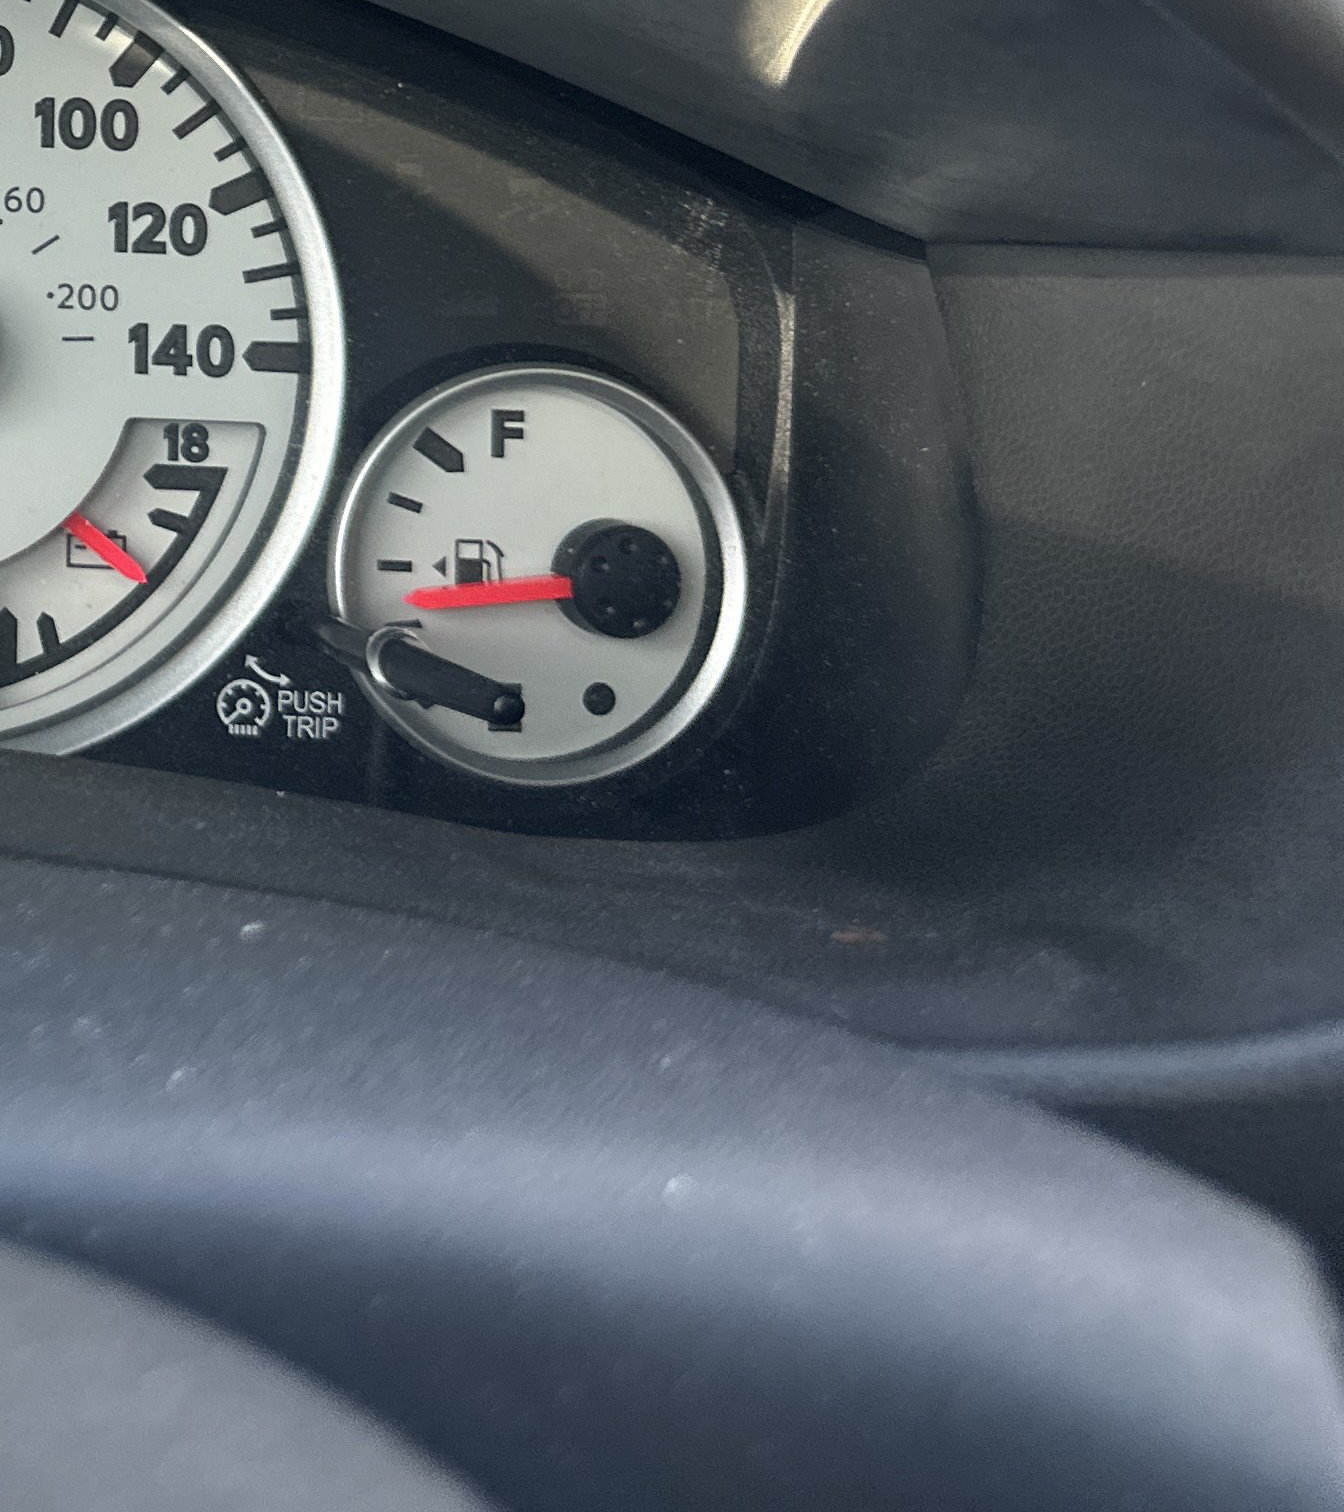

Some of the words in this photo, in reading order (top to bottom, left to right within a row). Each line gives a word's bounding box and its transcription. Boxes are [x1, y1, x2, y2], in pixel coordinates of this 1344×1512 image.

[34, 97, 138, 150] 100
[107, 202, 206, 254] 120
[58, 284, 119, 311] 200
[129, 324, 234, 376] 140
[163, 423, 209, 461] 18
[491, 409, 525, 458] F
[278, 691, 342, 714] PUSH
[283, 716, 339, 738] TRIP
